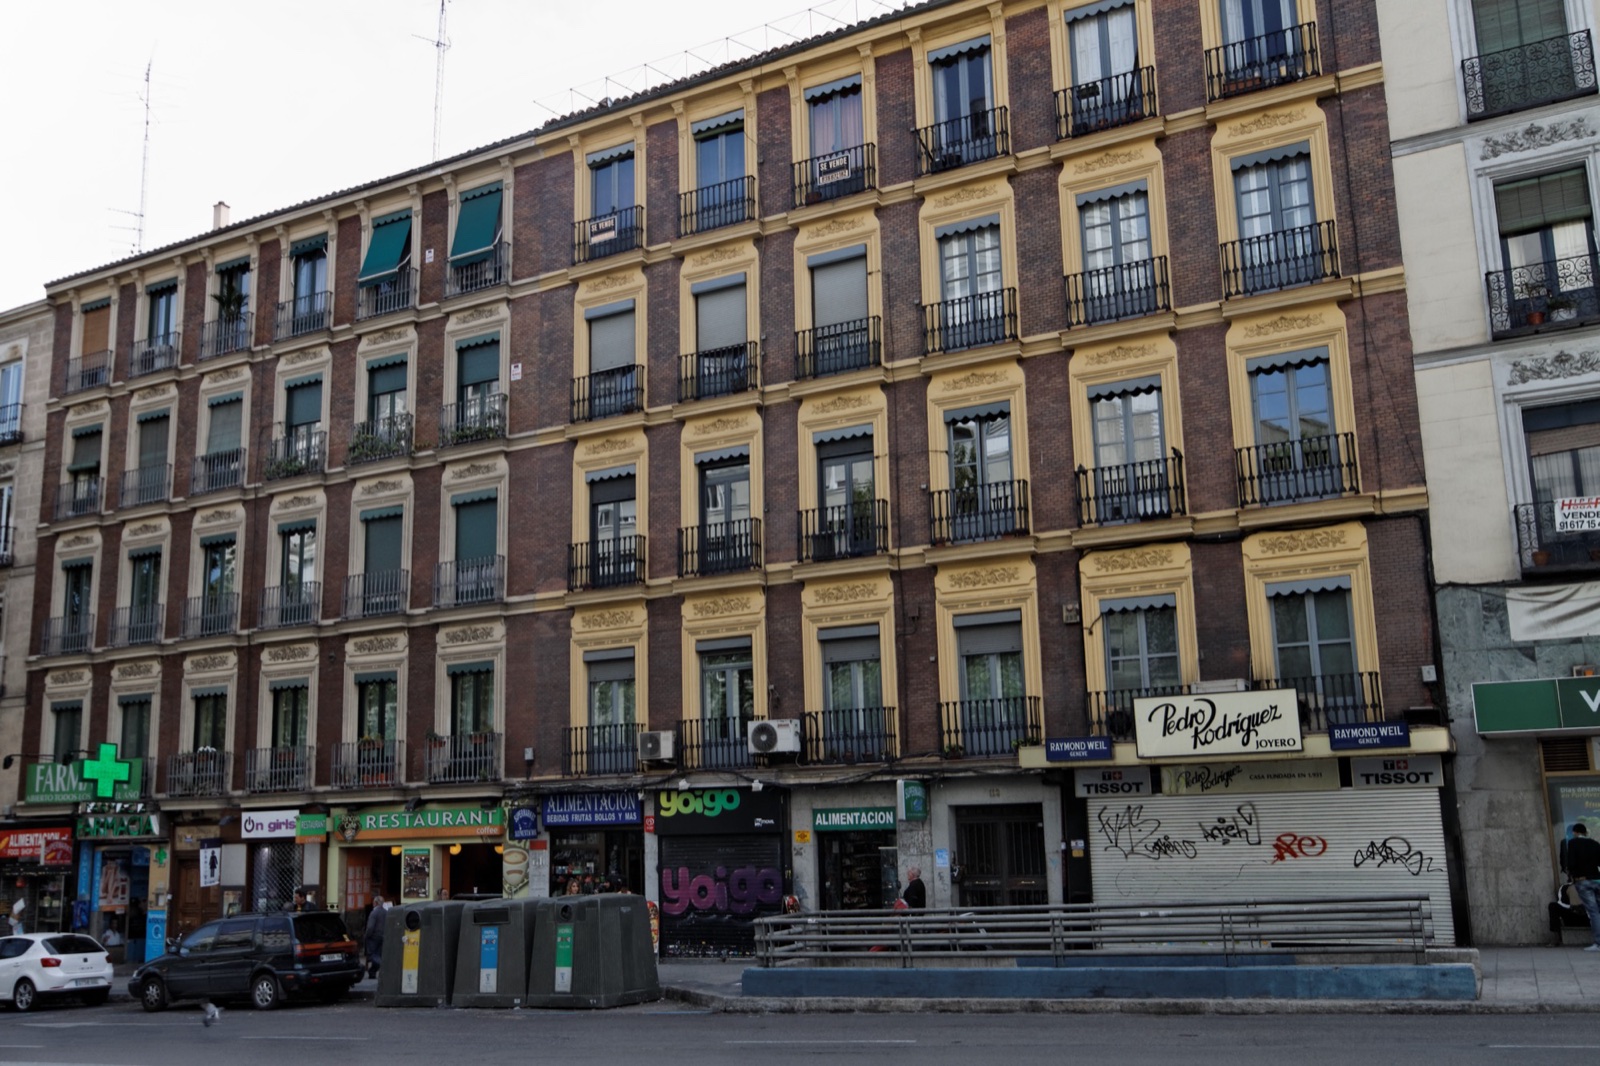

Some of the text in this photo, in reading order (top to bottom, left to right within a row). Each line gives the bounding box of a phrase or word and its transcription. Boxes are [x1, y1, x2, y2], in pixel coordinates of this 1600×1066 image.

[829, 157, 847, 168] VENDE
[1334, 726, 1403, 739] RAYMOND WEIL
[1050, 741, 1107, 751] RAYMOND WEIL
[1256, 738, 1296, 749] JOYERO
[1361, 772, 1433, 784] TISSOT
[1083, 782, 1143, 794] TISSOT
[660, 789, 740, 817] yoigo
[366, 809, 497, 829] RESTAURANT
[547, 811, 637, 822] BEBIDAS FRUTAS BOLLOS Y MAS
[815, 811, 894, 826] ALIMENTACION
[268, 819, 296, 832] girls
[476, 826, 498, 834] coffee
[662, 866, 783, 915] yoigo
